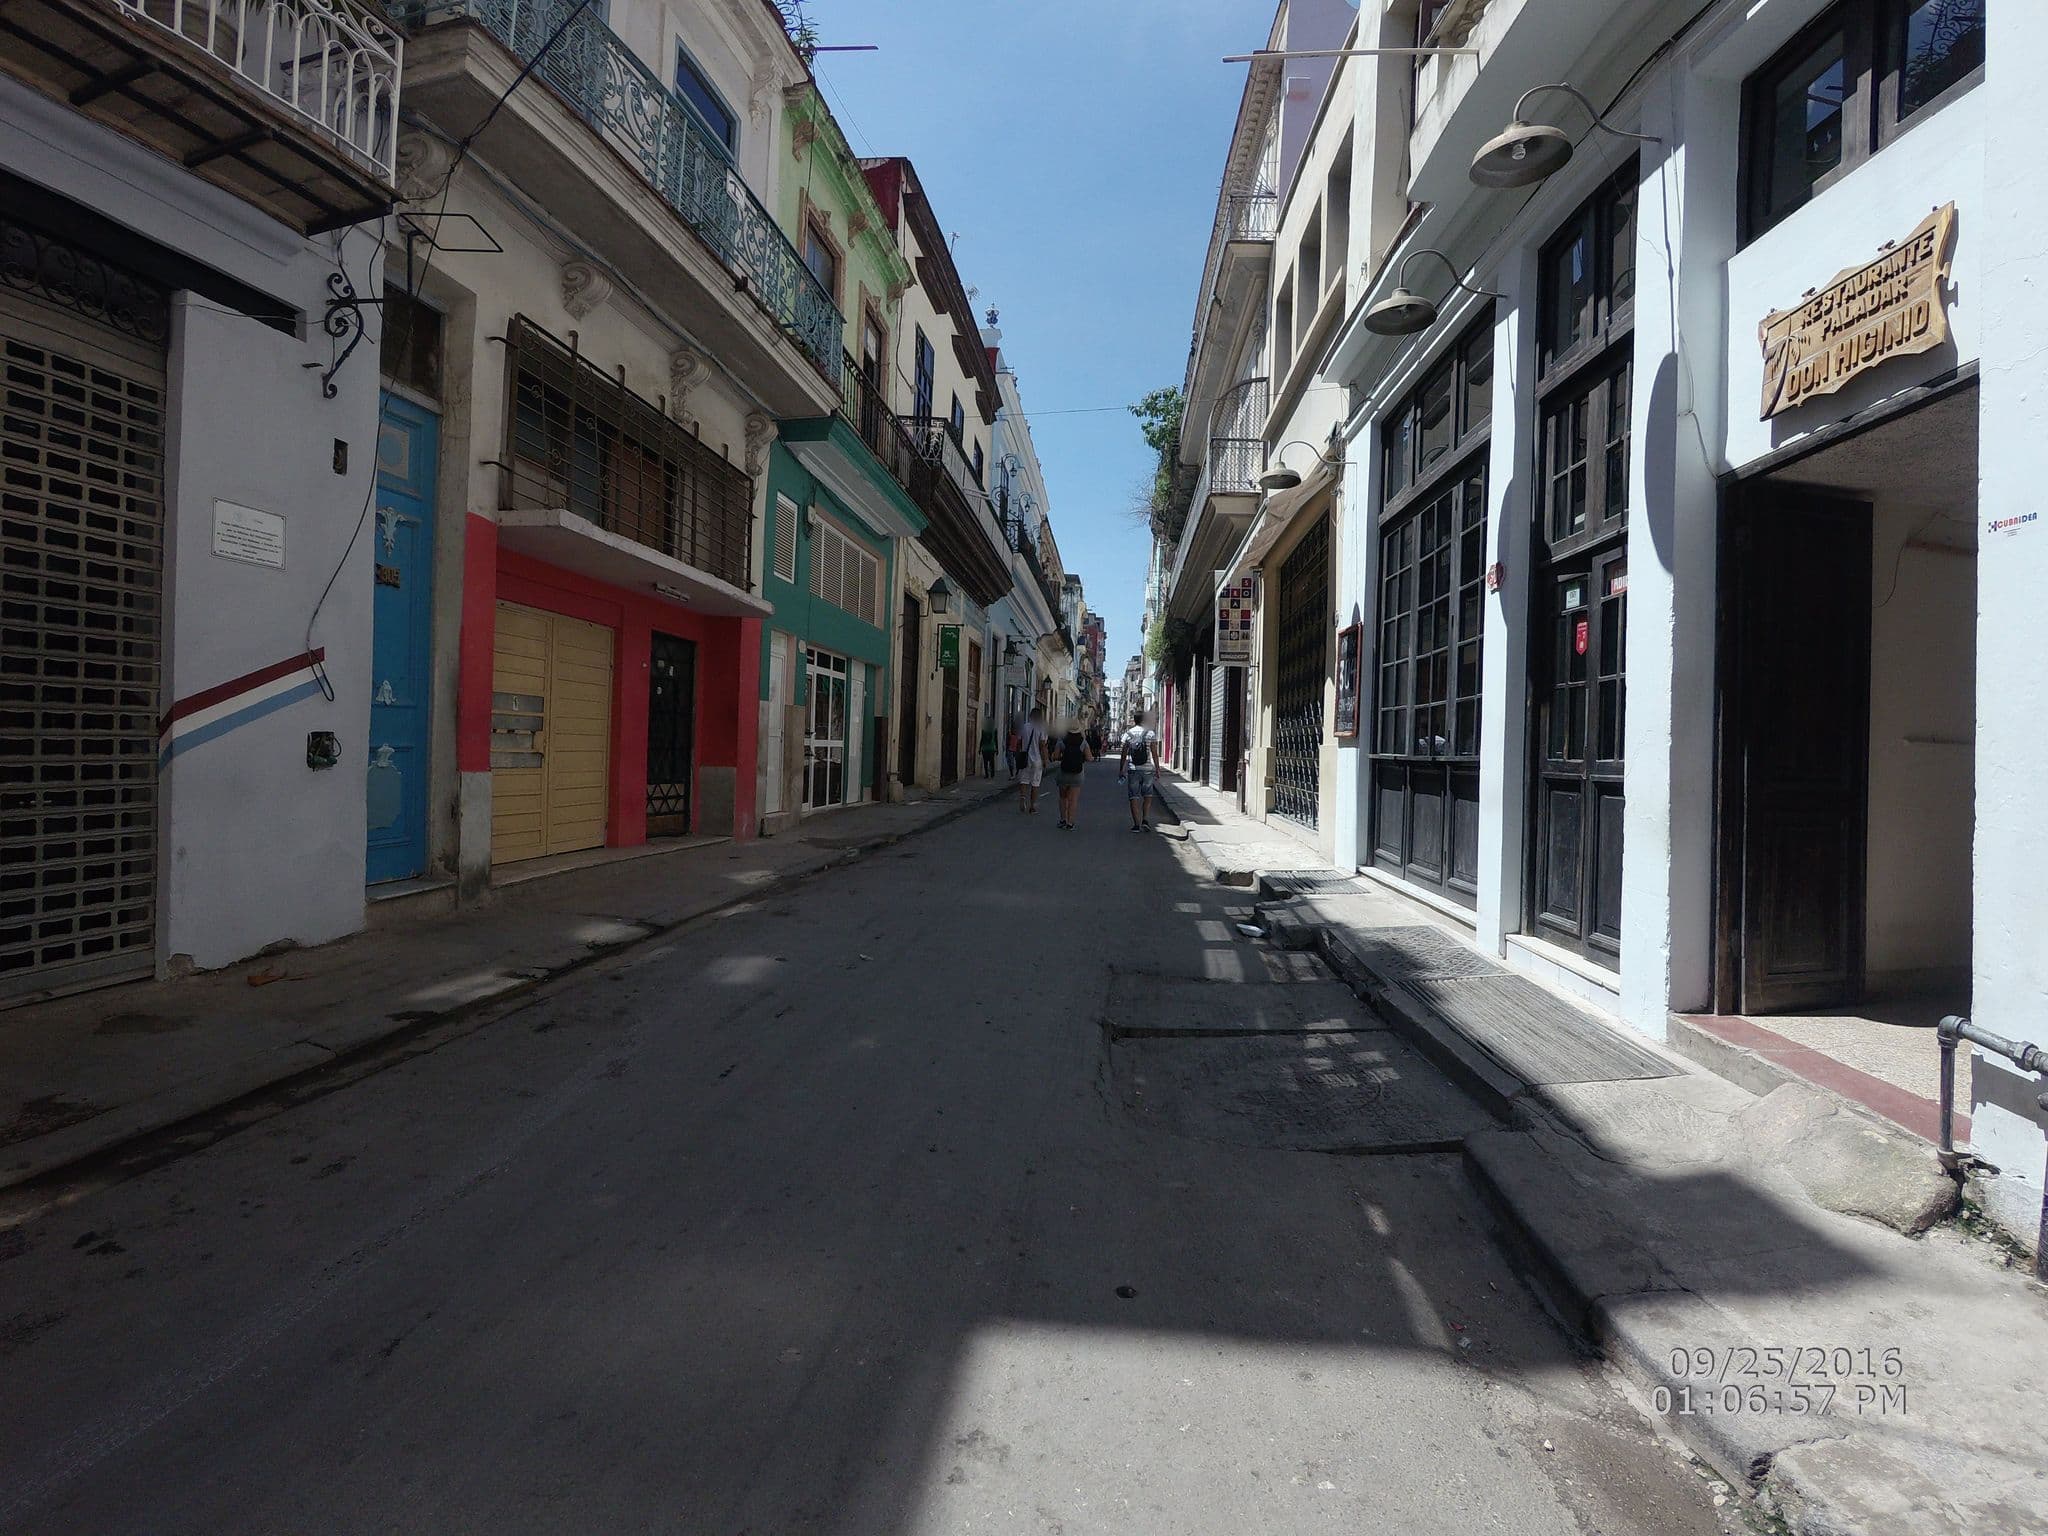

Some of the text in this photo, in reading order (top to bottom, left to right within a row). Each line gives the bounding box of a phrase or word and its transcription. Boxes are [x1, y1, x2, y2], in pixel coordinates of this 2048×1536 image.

[1800, 231, 1935, 330] RESTAURANTE
[1822, 279, 1908, 342] PALADAR
[1787, 300, 1930, 402] DON HIGINIO
